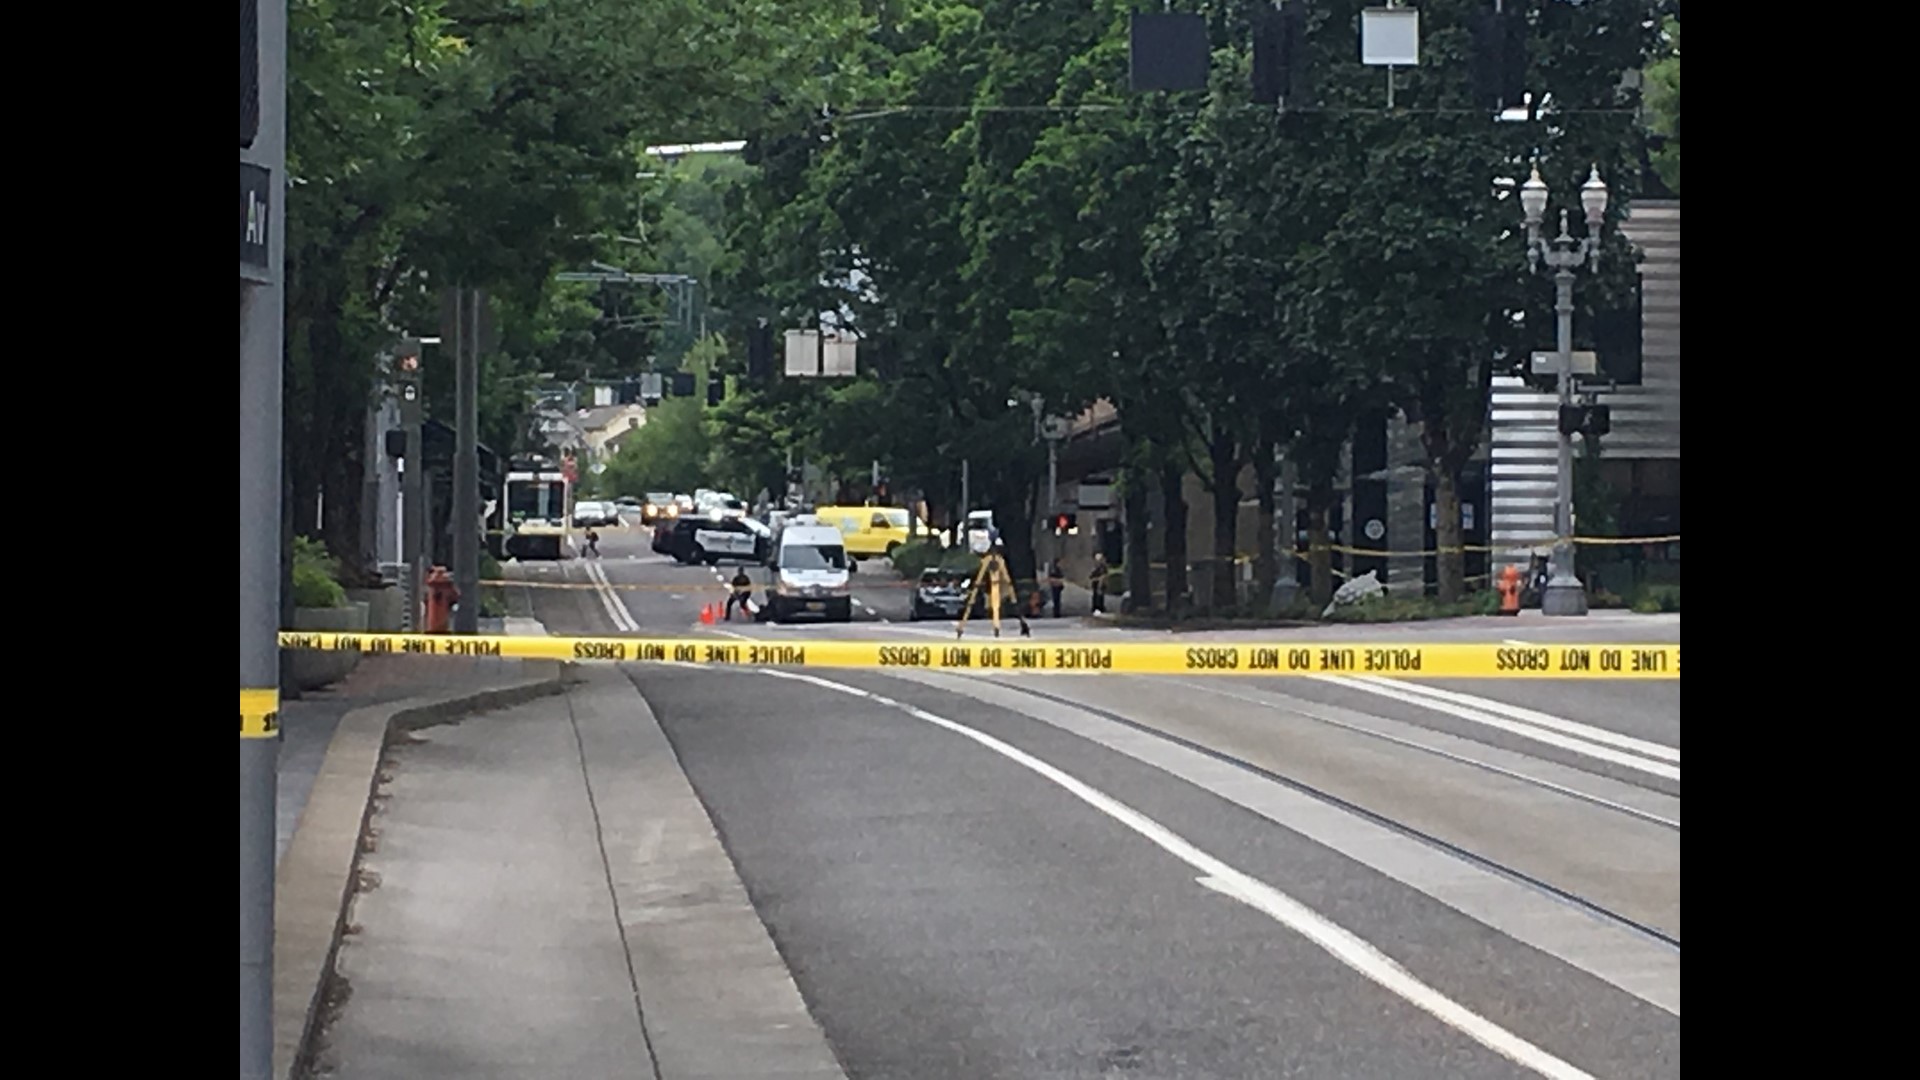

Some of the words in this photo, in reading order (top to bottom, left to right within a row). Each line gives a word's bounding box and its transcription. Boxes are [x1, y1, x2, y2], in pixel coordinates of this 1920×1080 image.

[574, 642, 625, 660] CROSS
[636, 643, 665, 661] NOT
[674, 644, 695, 662] DO
[705, 645, 739, 663] LINE
[750, 645, 804, 664] POLICE
[879, 646, 930, 666] CROSS
[941, 647, 970, 667] NOT
[980, 648, 1000, 667] DO
[1011, 648, 1045, 668] LINE
[1056, 648, 1112, 669] POLICE
[1186, 648, 1238, 669] CROSS
[1248, 648, 1278, 669] NOT
[1288, 649, 1310, 670] DO
[1320, 649, 1354, 670] LINE
[1365, 649, 1421, 670] POLICE
[1496, 648, 1549, 670] CROSS
[1560, 649, 1590, 671] NOT
[1600, 649, 1621, 671] DO
[1631, 650, 1667, 671] LINE
